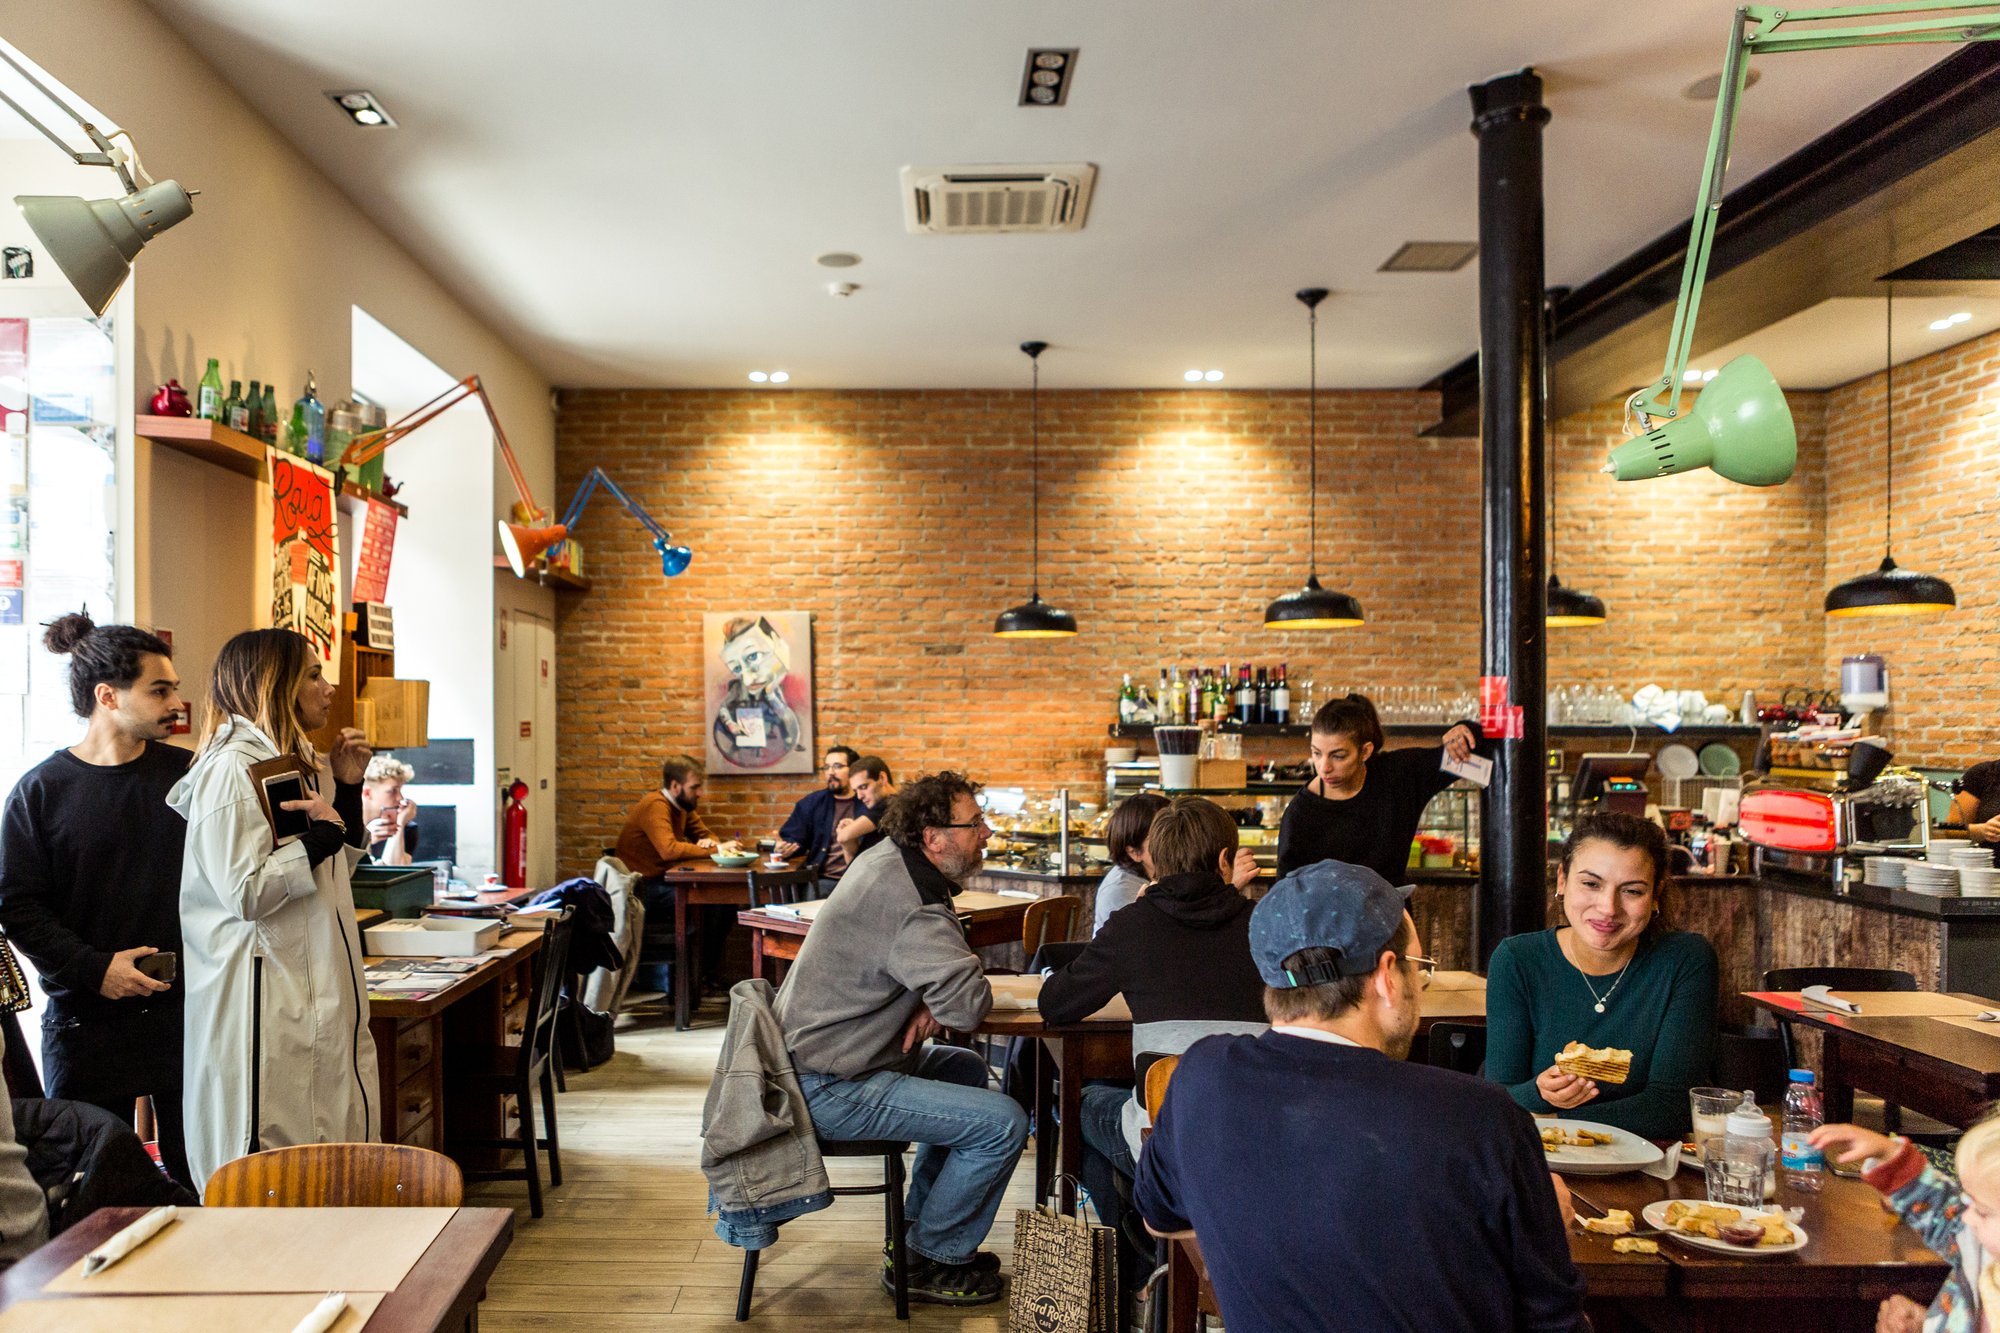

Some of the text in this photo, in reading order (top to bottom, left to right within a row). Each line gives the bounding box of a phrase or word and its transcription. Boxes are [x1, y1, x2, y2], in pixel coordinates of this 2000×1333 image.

[1023, 1296, 1047, 1316] Hard
[1047, 1305, 1071, 1327] Rock
[1039, 1319, 1052, 1329] CAFE
